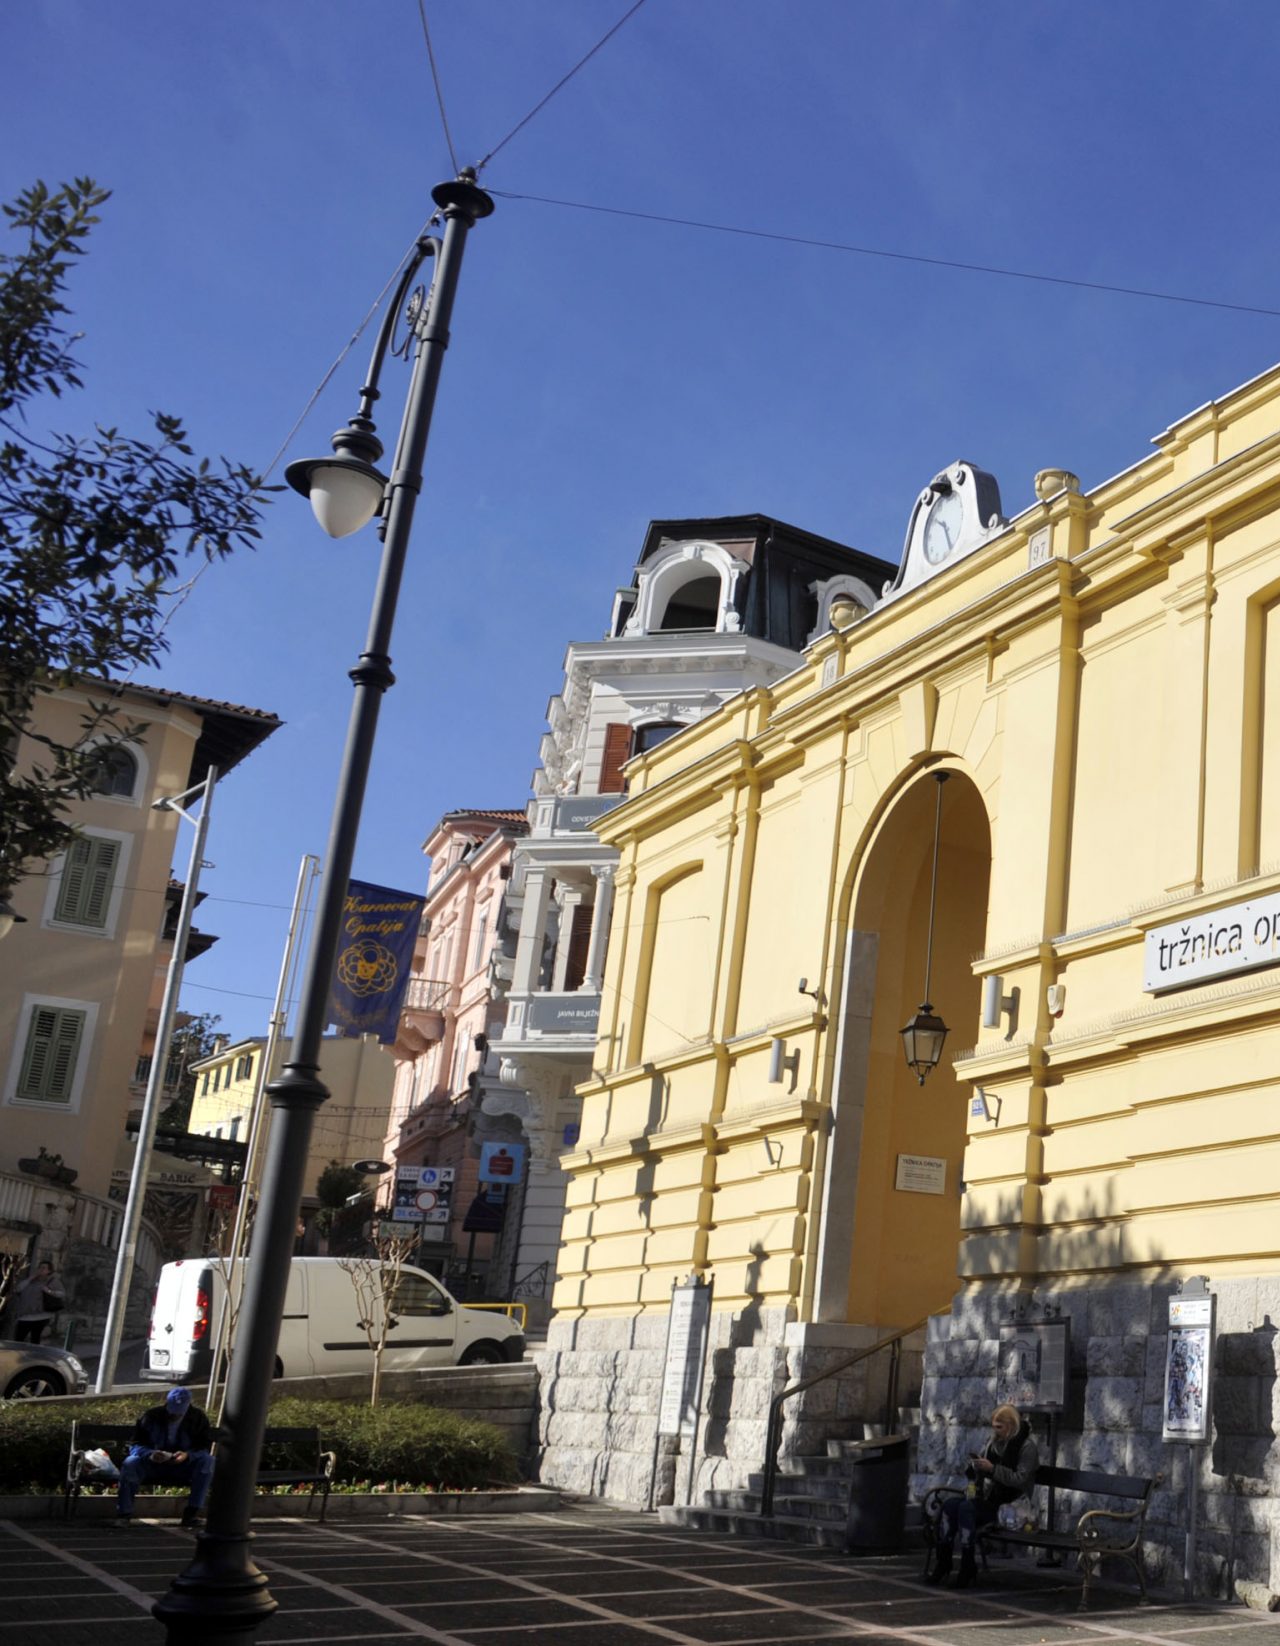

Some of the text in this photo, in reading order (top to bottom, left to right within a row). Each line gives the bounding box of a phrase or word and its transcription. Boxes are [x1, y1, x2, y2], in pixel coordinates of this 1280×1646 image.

[1033, 542, 1046, 560] 97
[345, 916, 405, 937] Opatija
[1158, 922, 1242, 972] tržnica
[557, 1010, 575, 1019] JAVNI
